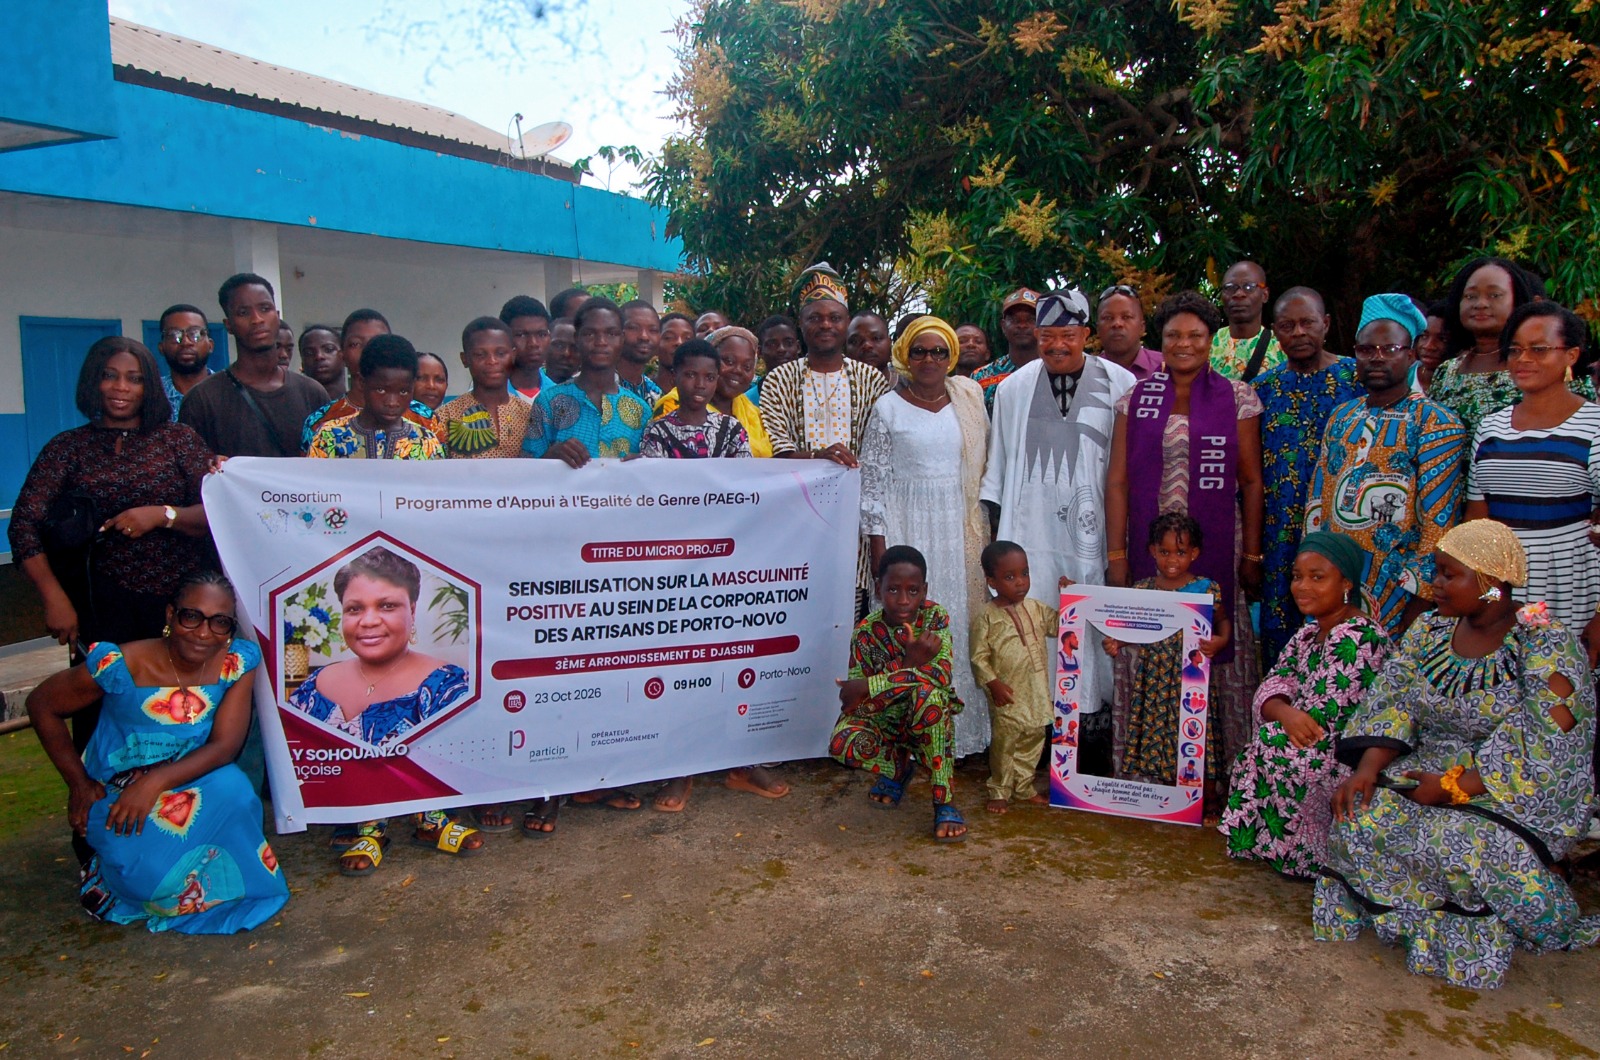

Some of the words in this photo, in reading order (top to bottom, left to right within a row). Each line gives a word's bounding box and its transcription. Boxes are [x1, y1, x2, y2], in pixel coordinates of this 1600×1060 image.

[1136, 371, 1170, 419] PAEG
[1199, 435, 1227, 490] PAEG
[261, 489, 342, 503] Consortium
[395, 496, 493, 512] Programme
[496, 495, 555, 510] d'Appui
[559, 495, 569, 508] à
[572, 494, 632, 510] l'Egalité
[636, 494, 655, 507] de
[658, 493, 700, 507] Genre
[703, 492, 760, 507] (PAEG-1)
[591, 546, 624, 559] TITRE
[626, 546, 643, 557] DU
[645, 544, 684, 556] MICRO
[686, 543, 729, 555] PROJET
[508, 576, 654, 597] SENSIBILISATION
[656, 574, 687, 590] SUR
[690, 572, 709, 588] LA
[712, 562, 809, 586] MASCULINITÉ
[506, 603, 586, 621] POSITIVE
[589, 601, 615, 617] AU
[617, 599, 654, 615] SEIN
[656, 597, 676, 613] DE
[678, 596, 698, 611] LA
[700, 587, 809, 609] CORPORATION
[534, 628, 568, 644] DES
[571, 621, 654, 642] ARTISANS
[657, 619, 678, 635] DE
[680, 611, 787, 633] PORTO-NOVO
[554, 657, 586, 670] 3ÈME
[588, 650, 690, 668] ARRONDISSEMENT
[692, 648, 706, 659] DE
[710, 644, 754, 657] DJASSIN
[759, 666, 811, 680] Porto-Novo
[534, 692, 549, 704] 23
[551, 691, 572, 703] Oct
[574, 687, 602, 700] 2026
[591, 729, 630, 739] OPÉRATEUR
[591, 732, 660, 747] D'ACCOMPAGNEMENT
[306, 743, 410, 761] SOHOUANZO
[529, 745, 566, 759] particip
[1091, 786, 1111, 794] chaque
[1112, 787, 1130, 795] homme
[1132, 789, 1142, 797] doit
[1150, 793, 1163, 801] être
[1121, 782, 1142, 791] n'attend
